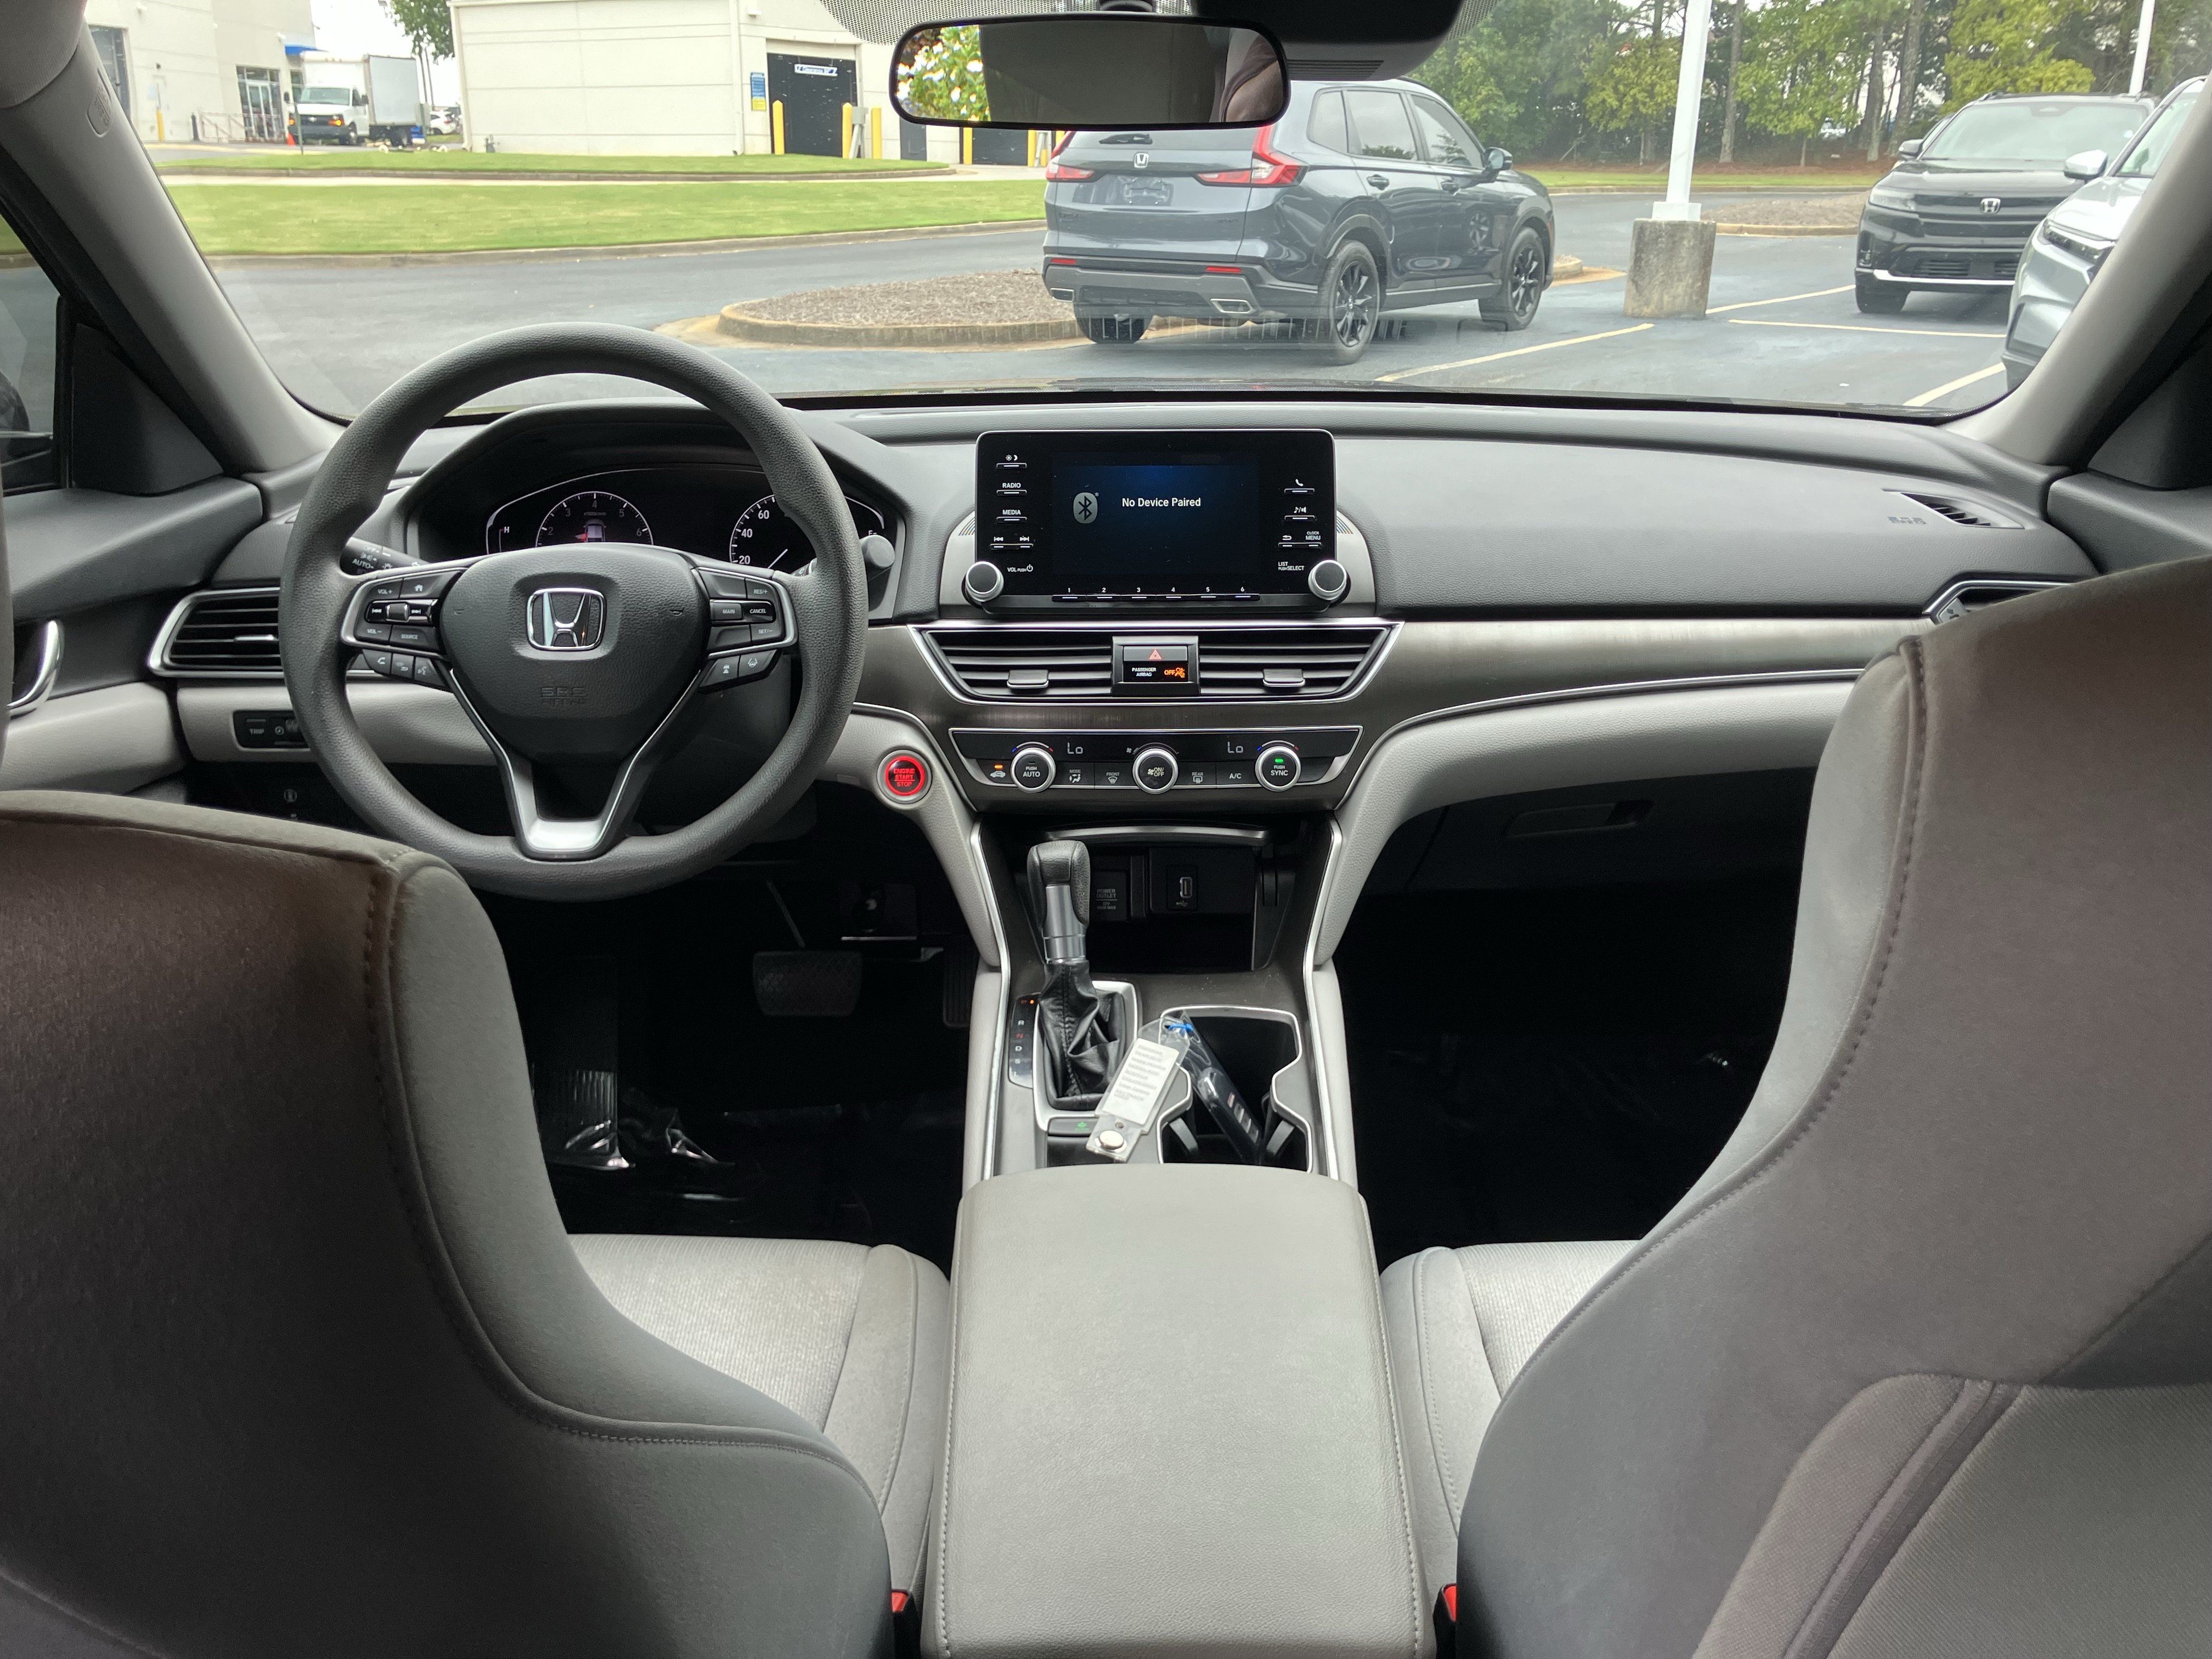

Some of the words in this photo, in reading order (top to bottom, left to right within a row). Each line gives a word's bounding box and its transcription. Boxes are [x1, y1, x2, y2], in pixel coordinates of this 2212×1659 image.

[591, 500, 597, 508] 4
[1122, 498, 1135, 507] No
[1138, 498, 1169, 507] Device
[1171, 498, 1201, 507] Paired
[565, 509, 571, 517] 3
[619, 509, 625, 517] 5
[758, 510, 770, 520] 60
[548, 527, 554, 535] 2
[636, 528, 642, 537] 6
[741, 528, 753, 538] 40
[352, 559, 371, 569] AUTO
[739, 555, 751, 565] 20
[1067, 742, 1084, 754] Lo
[1227, 741, 1244, 754] Lo
